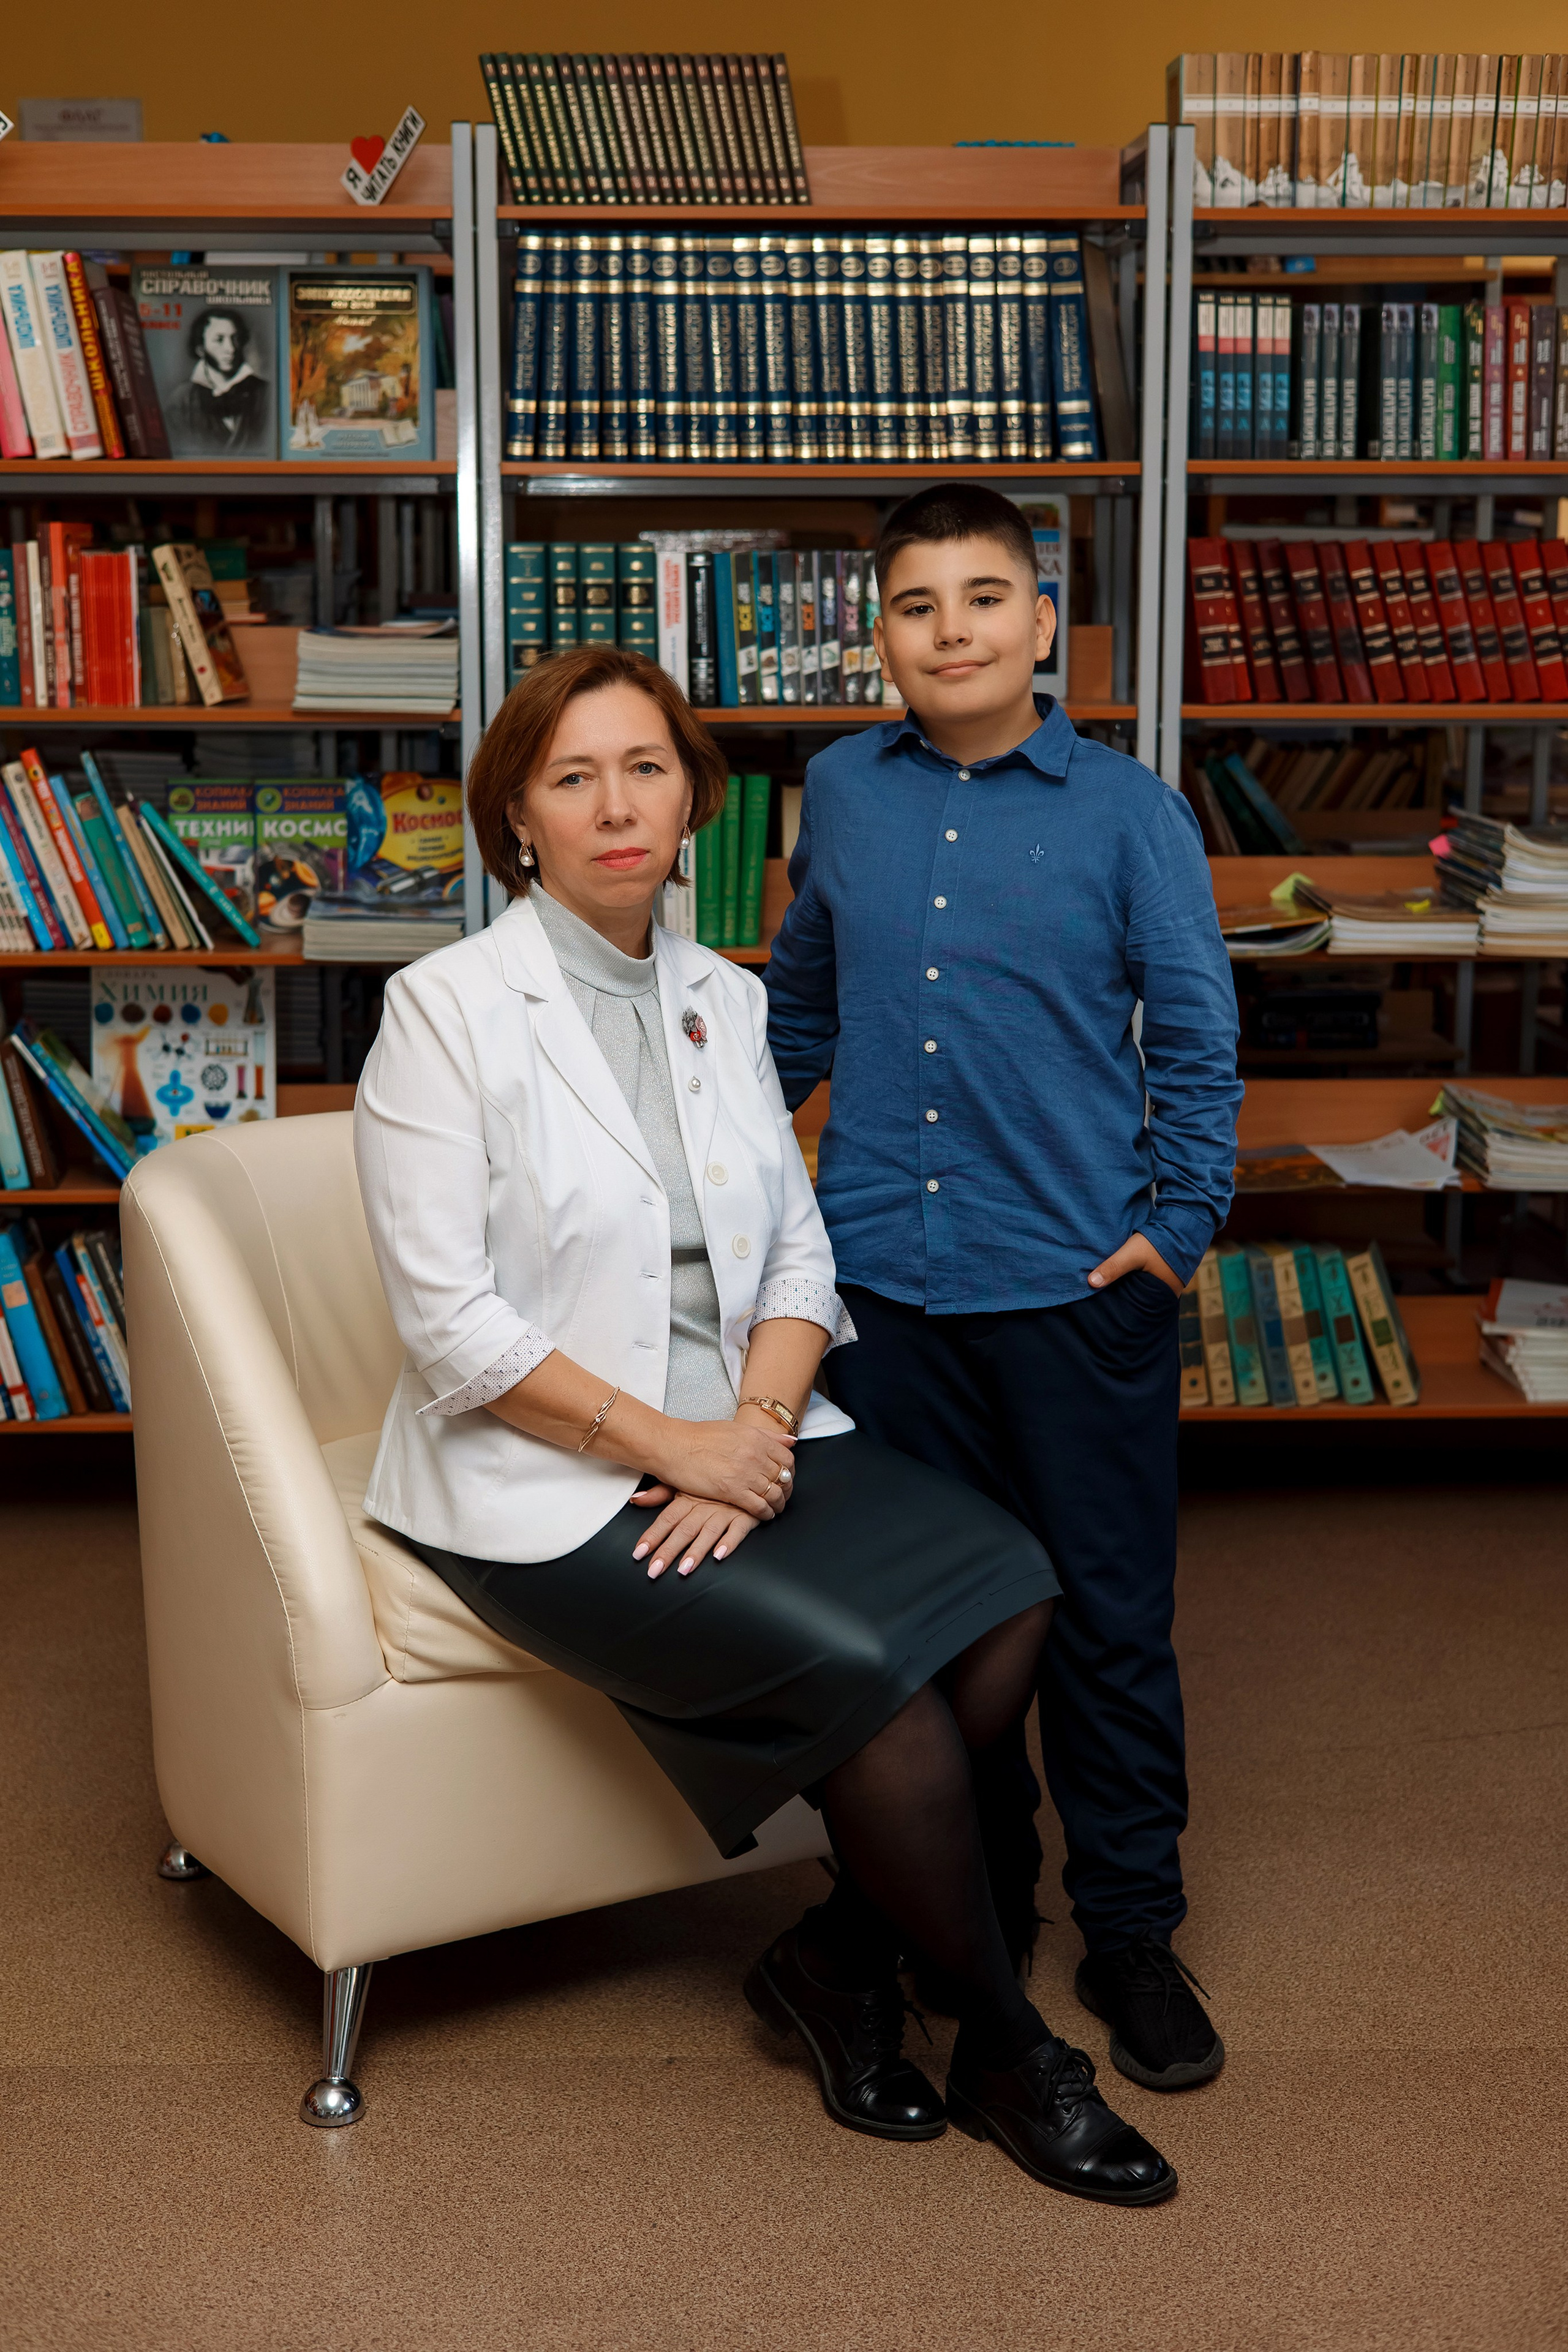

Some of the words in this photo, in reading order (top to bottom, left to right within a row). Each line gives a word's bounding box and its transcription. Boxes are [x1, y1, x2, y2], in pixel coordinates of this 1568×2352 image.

[346, 167, 363, 190] Я
[360, 156, 399, 202] ЧИТАТЬ
[141, 279, 271, 295] СПРАВОЧНИК
[8, 284, 36, 349] ШКОЛЬНИКА
[45, 284, 74, 349] ШКОЛЬНИКА
[67, 261, 105, 391] ШКОЛЬНИКА
[547, 414, 556, 429] 2
[691, 417, 701, 429] 7
[825, 417, 842, 429] 12
[878, 417, 893, 430] 14
[952, 415, 969, 428] 17
[979, 417, 994, 429] 18
[1006, 415, 1022, 428] 19
[739, 605, 753, 631] ВСЕ
[761, 606, 774, 633] ВСЕ
[802, 604, 816, 631] ВСЕ
[845, 605, 859, 632] ВСЕ
[195, 799, 247, 812] ЗНАНИЙ
[284, 799, 335, 812] ЗНАНИЙ
[263, 819, 347, 839] КОСМО
[98, 981, 208, 1002] ХИМИЯ
